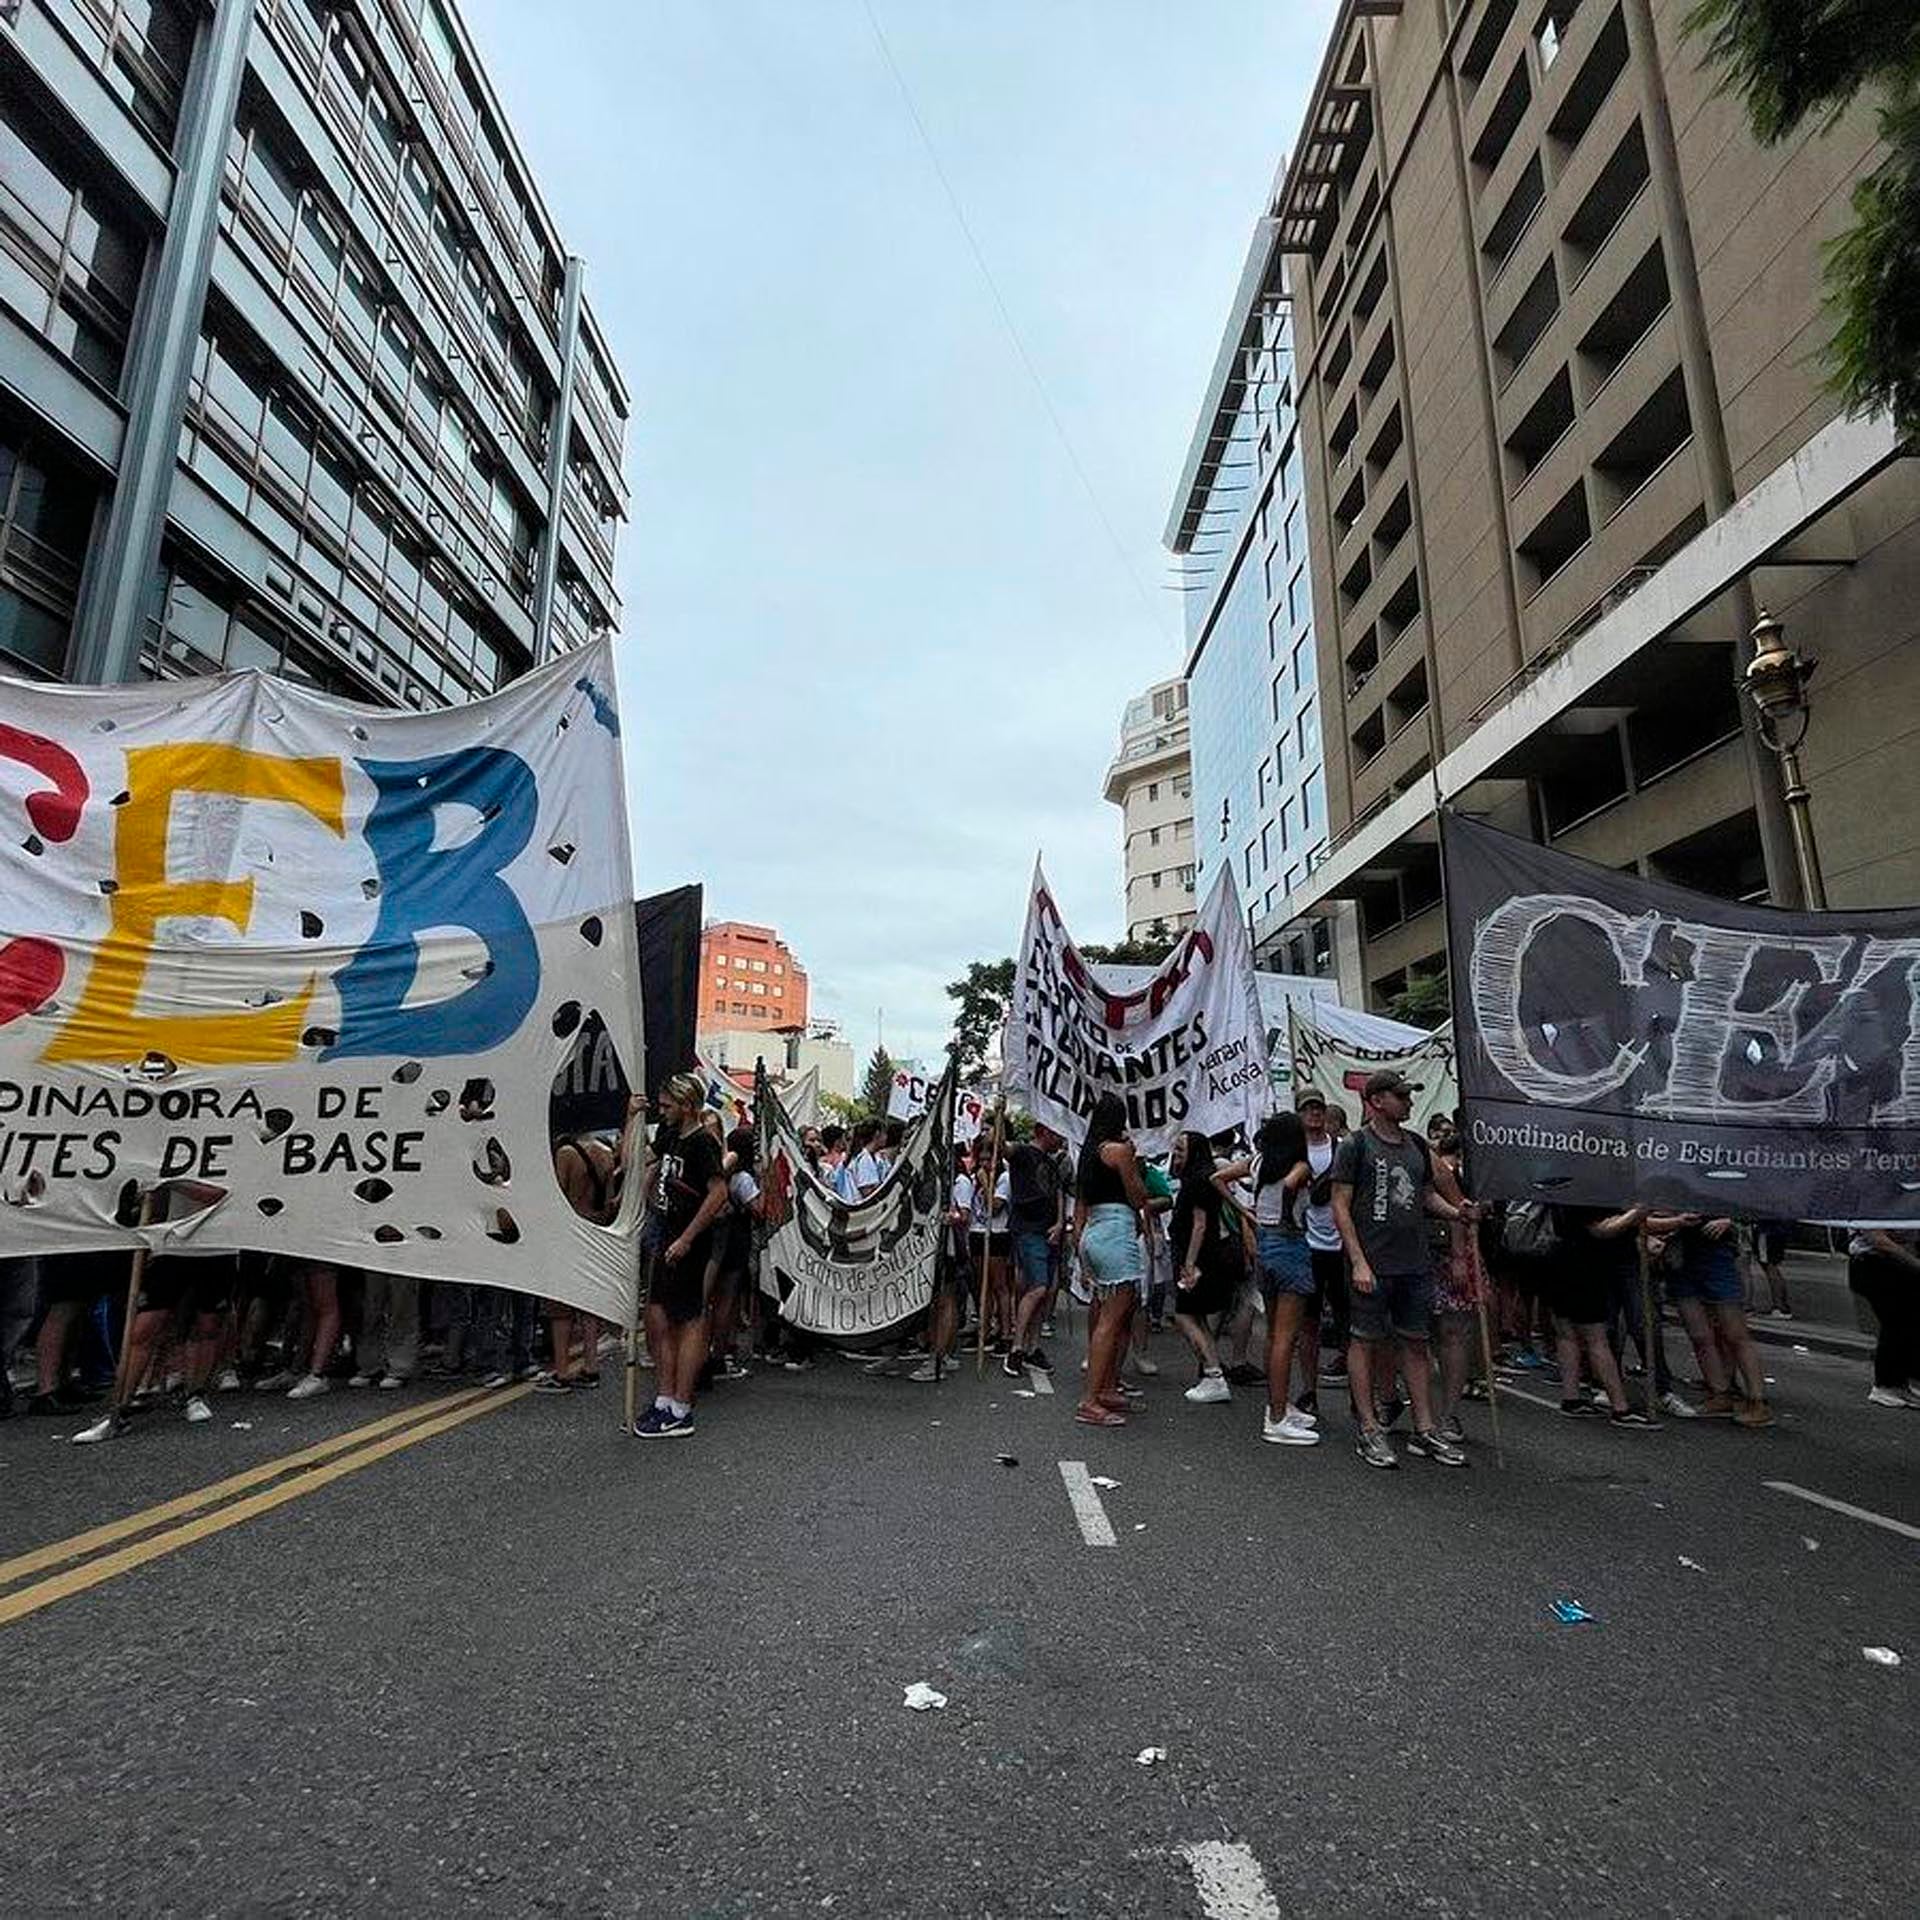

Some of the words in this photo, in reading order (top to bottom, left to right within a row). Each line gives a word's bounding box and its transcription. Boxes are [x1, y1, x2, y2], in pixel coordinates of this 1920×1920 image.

[318, 1086, 383, 1119] DE
[160, 1135, 233, 1178] DE
[283, 1130, 425, 1176] BASE
[1473, 1119, 1629, 1159] Coordinadora
[1636, 1137, 1670, 1162] de
[1679, 1141, 1851, 1171] Estudiantes
